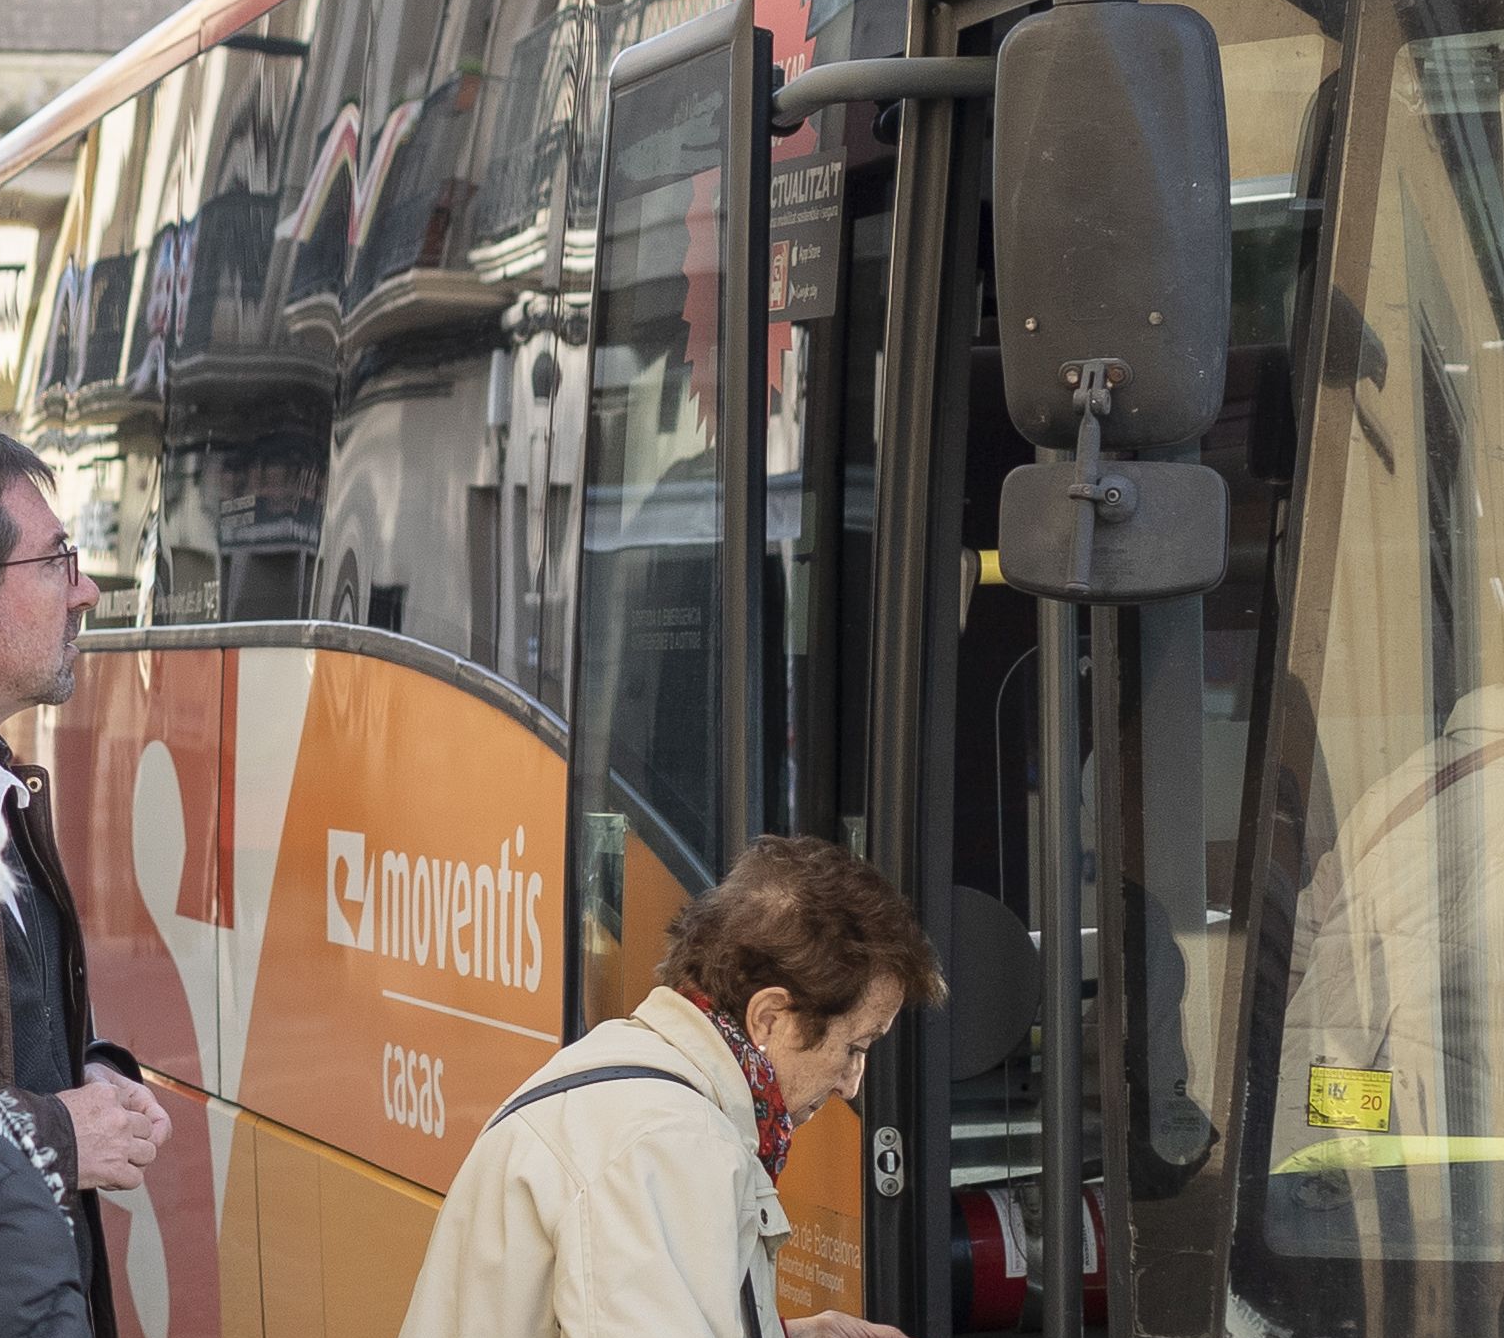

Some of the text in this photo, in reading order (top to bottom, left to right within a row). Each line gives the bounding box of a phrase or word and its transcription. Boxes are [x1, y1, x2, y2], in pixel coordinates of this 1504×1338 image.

[381, 824, 544, 994] moventis
[382, 1041, 446, 1140] casas
[1360, 1094, 1383, 1111] 20
[814, 1223, 861, 1270] Barcelona
